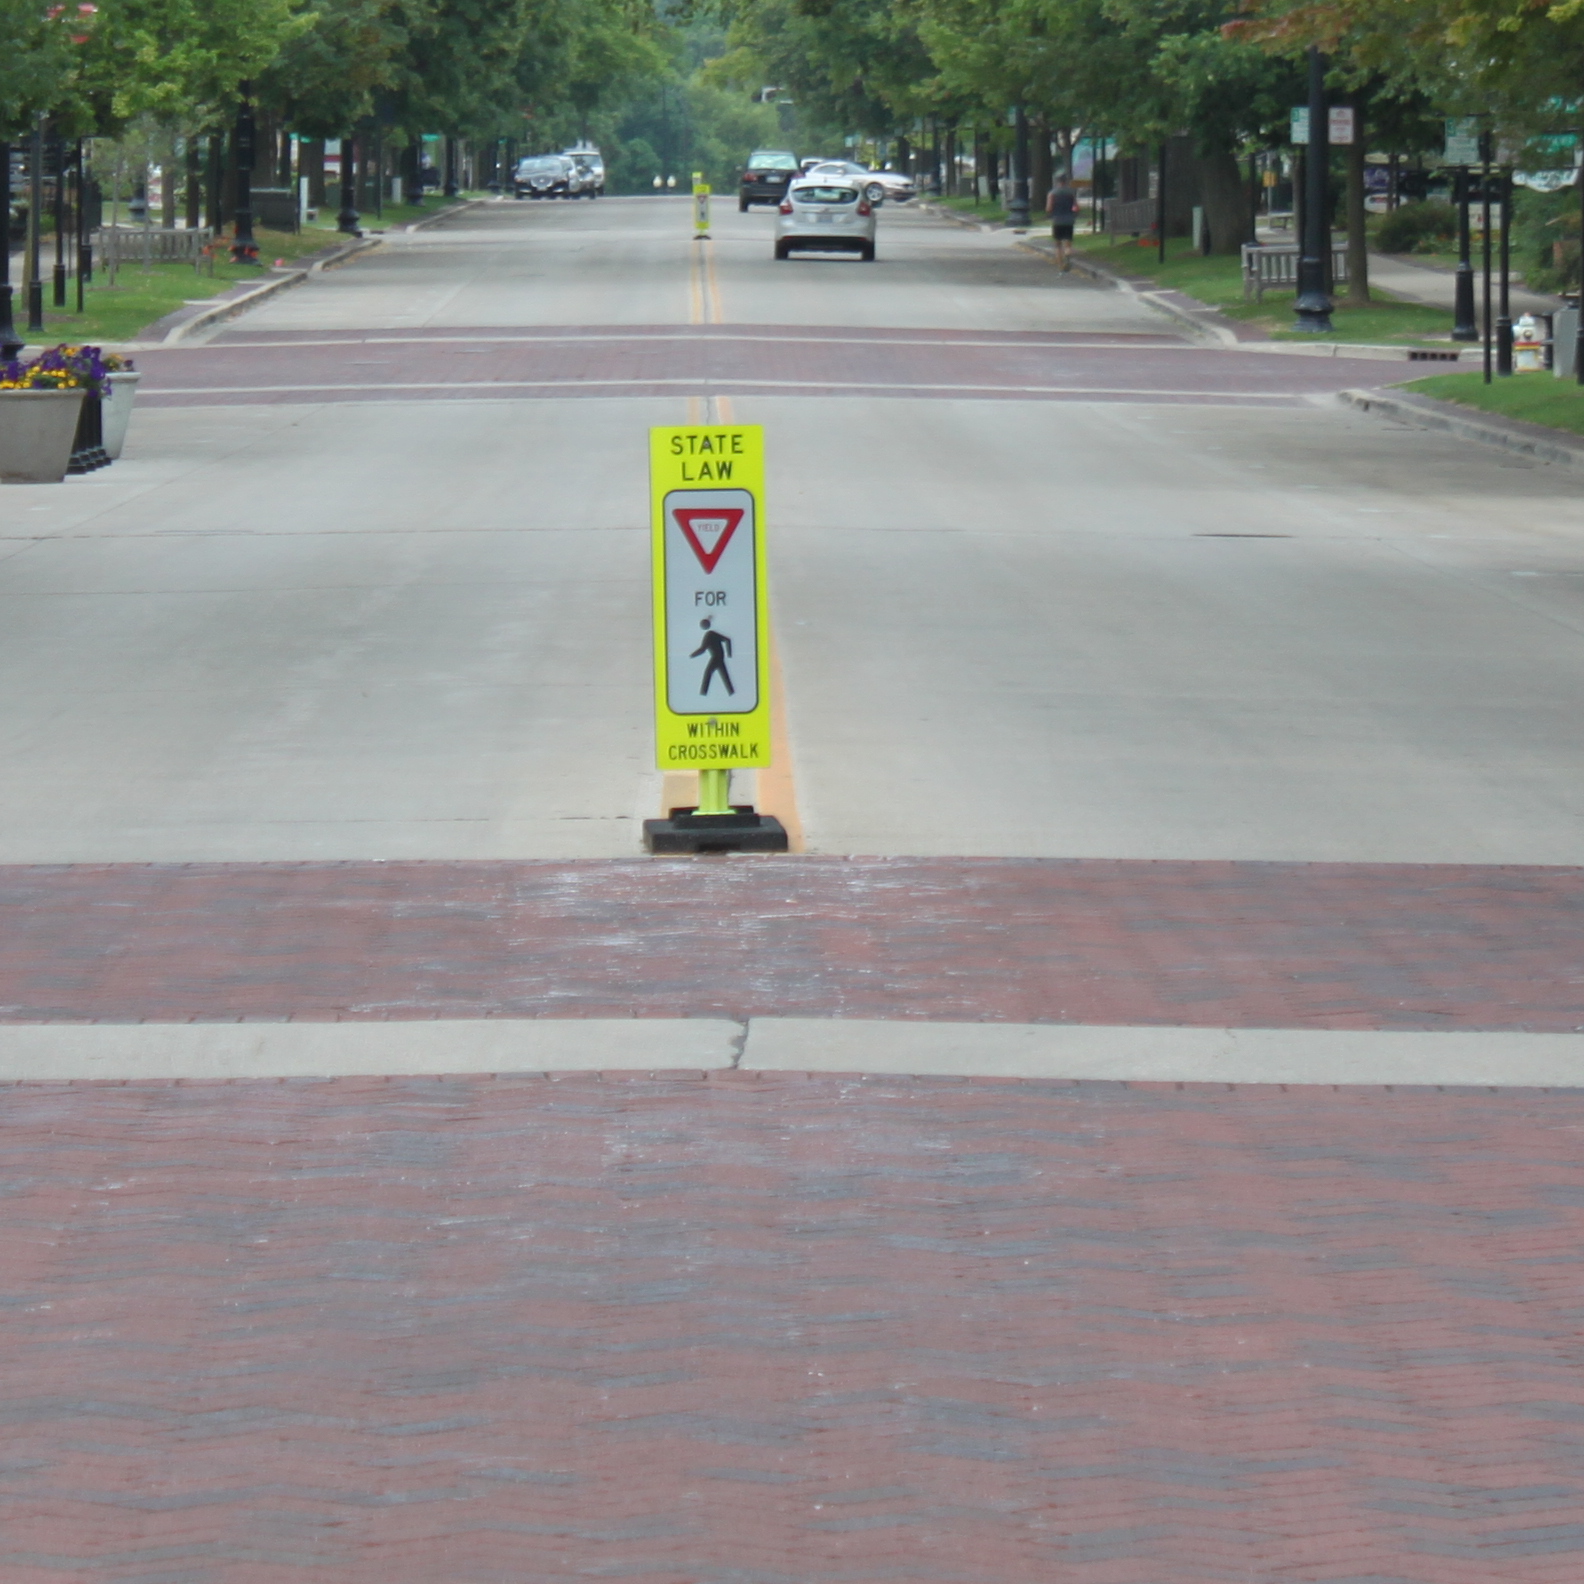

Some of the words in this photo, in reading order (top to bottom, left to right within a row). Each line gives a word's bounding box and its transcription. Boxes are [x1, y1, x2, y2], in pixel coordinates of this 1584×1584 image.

[671, 435, 745, 456] STATE
[682, 461, 734, 481] LAW
[697, 523, 720, 532] YIELD
[695, 591, 727, 607] FOR
[687, 722, 740, 738] WITHIN
[668, 742, 760, 760] CROSSWALK
